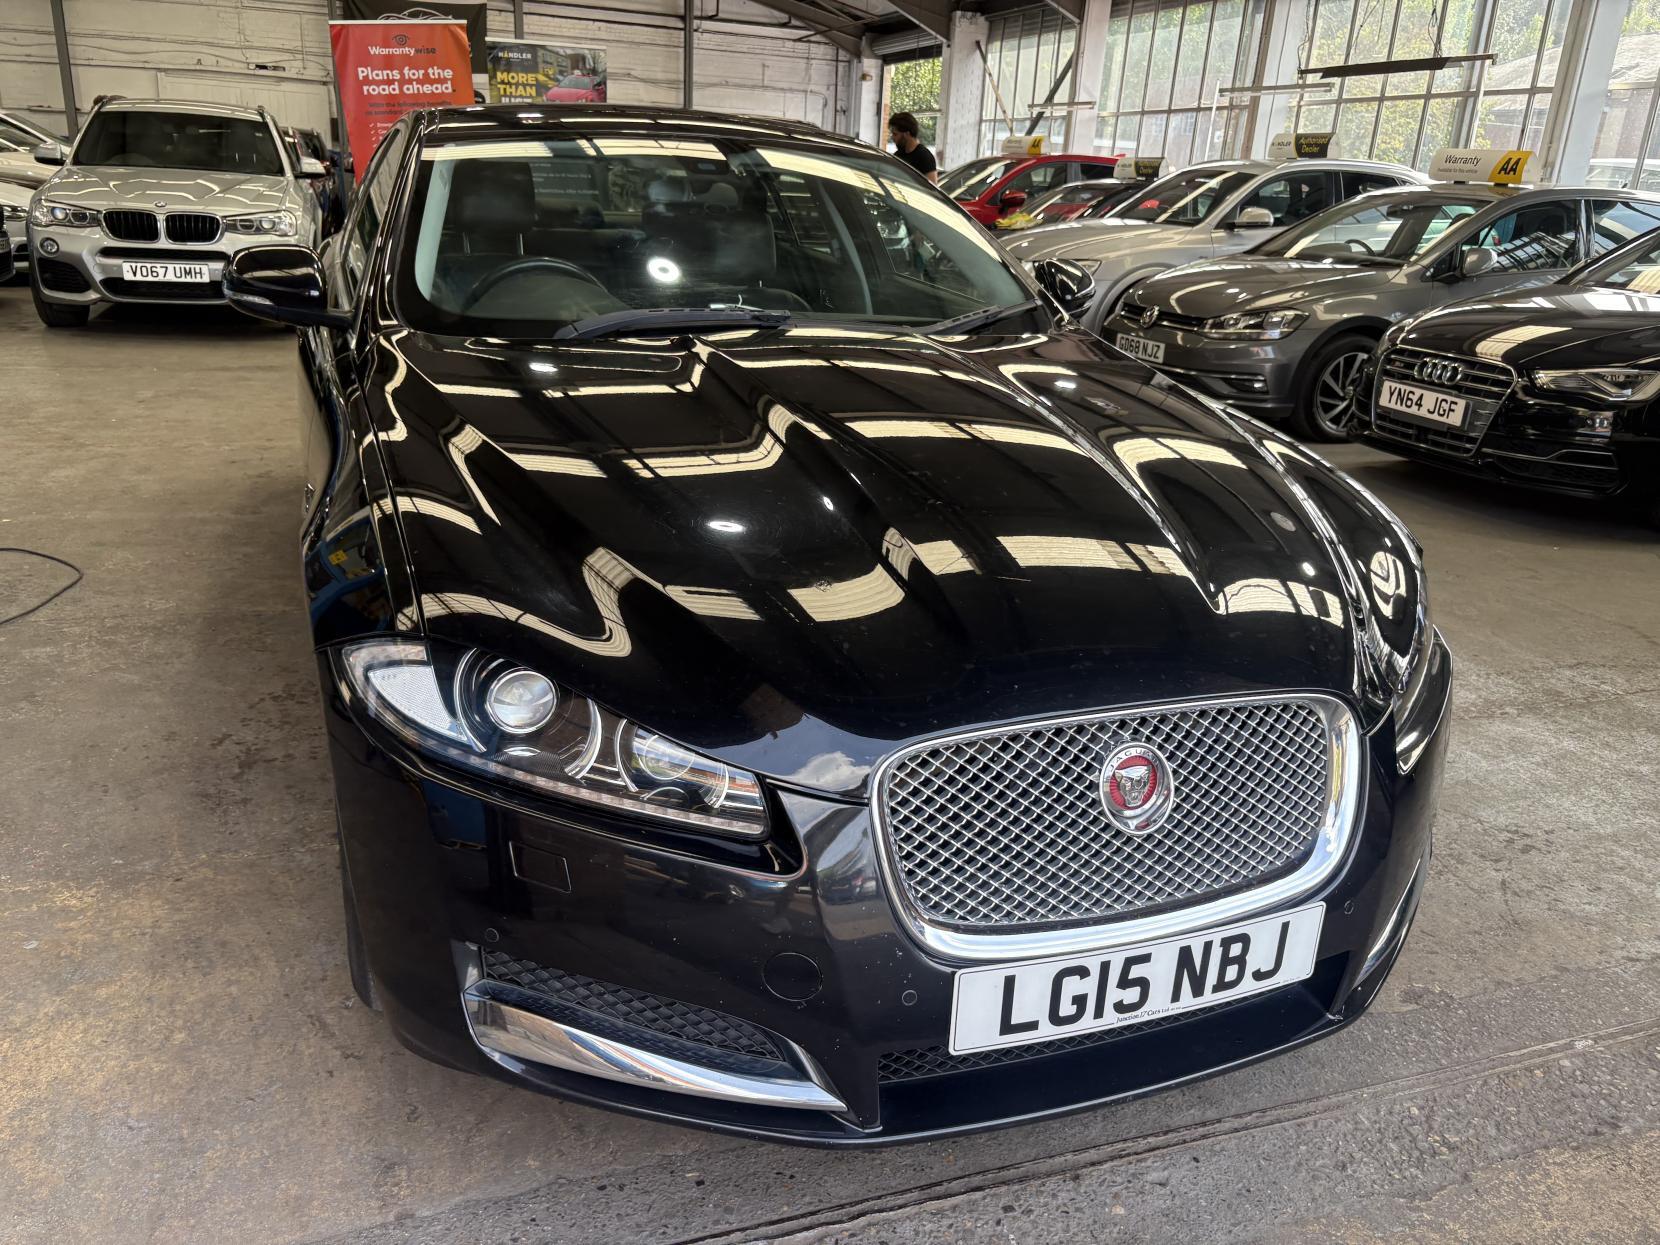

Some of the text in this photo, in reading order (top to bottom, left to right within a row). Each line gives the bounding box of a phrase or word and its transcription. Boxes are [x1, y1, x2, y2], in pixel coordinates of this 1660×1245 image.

[357, 66, 453, 80] Plans for the
[496, 71, 537, 85] MORE
[363, 80, 456, 95] road ahead.
[497, 84, 537, 97] THAN
[1444, 154, 1481, 166] Warranty
[1497, 157, 1522, 175] AA
[173, 266, 203, 279] UMH
[1141, 341, 1161, 360] NJZ
[1388, 385, 1458, 419] YN64 JGF
[998, 920, 1291, 1037] LG15 NBJ
[1147, 1009, 1161, 1017] Cars
